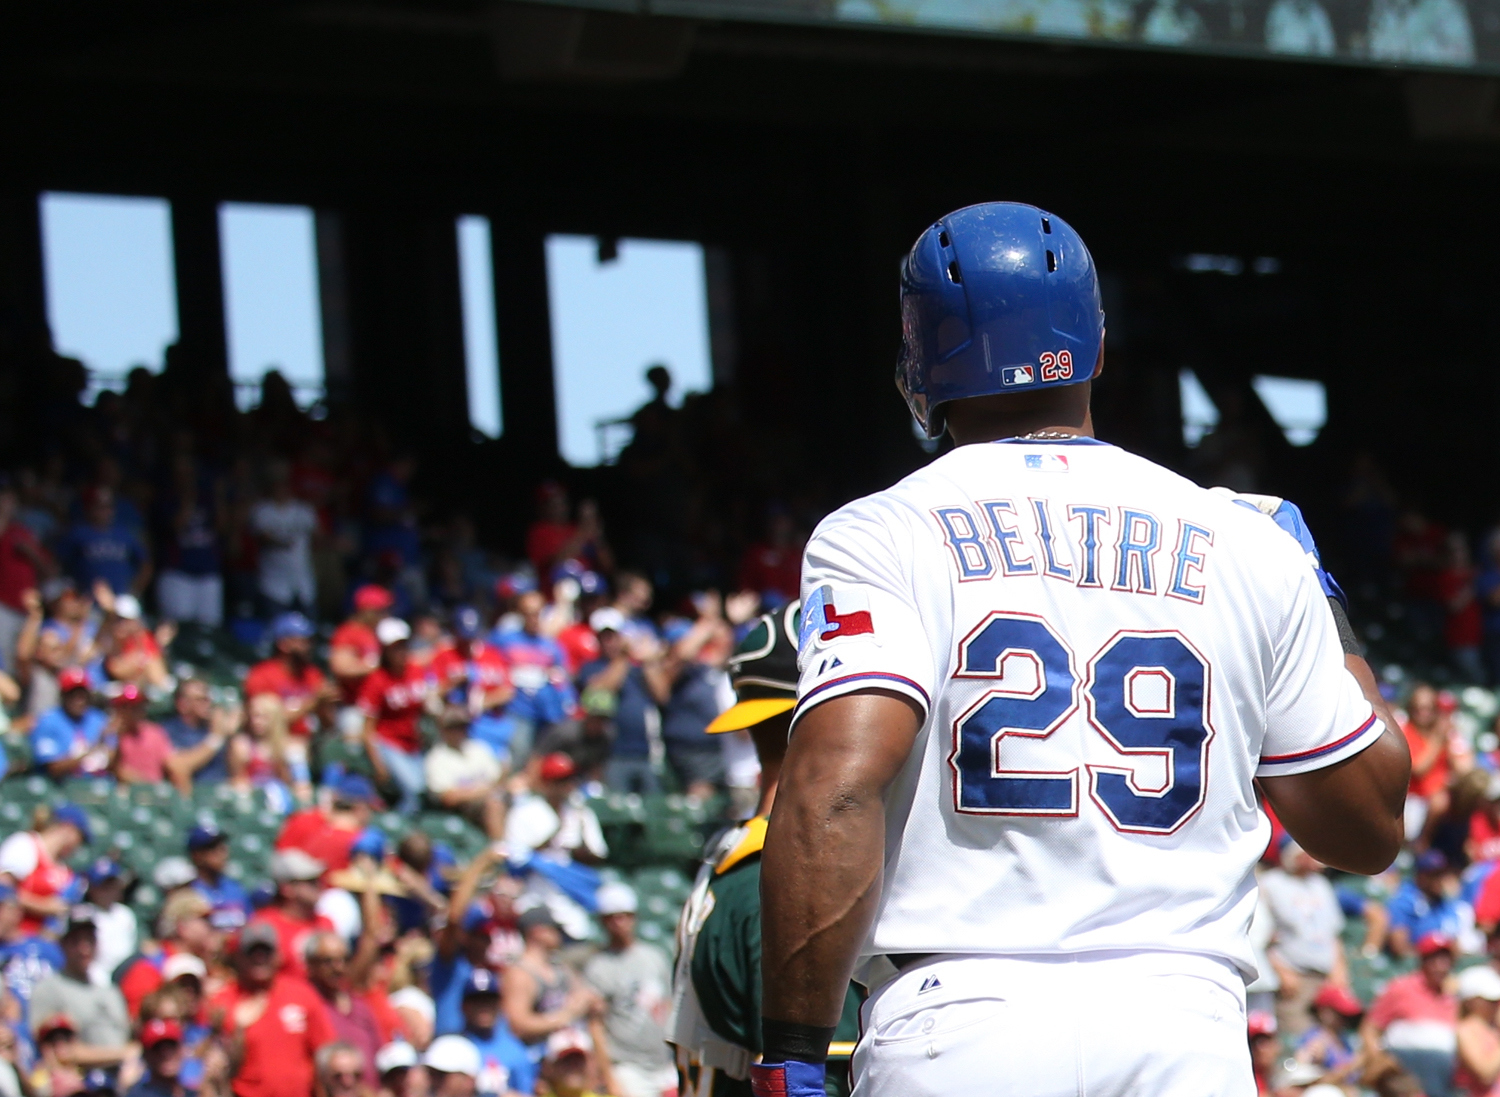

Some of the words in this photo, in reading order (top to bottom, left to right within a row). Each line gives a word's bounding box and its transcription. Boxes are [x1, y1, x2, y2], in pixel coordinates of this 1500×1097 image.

[1039, 350, 1073, 382] 29
[931, 497, 1214, 605] BELTRE
[947, 610, 1216, 835] 29
